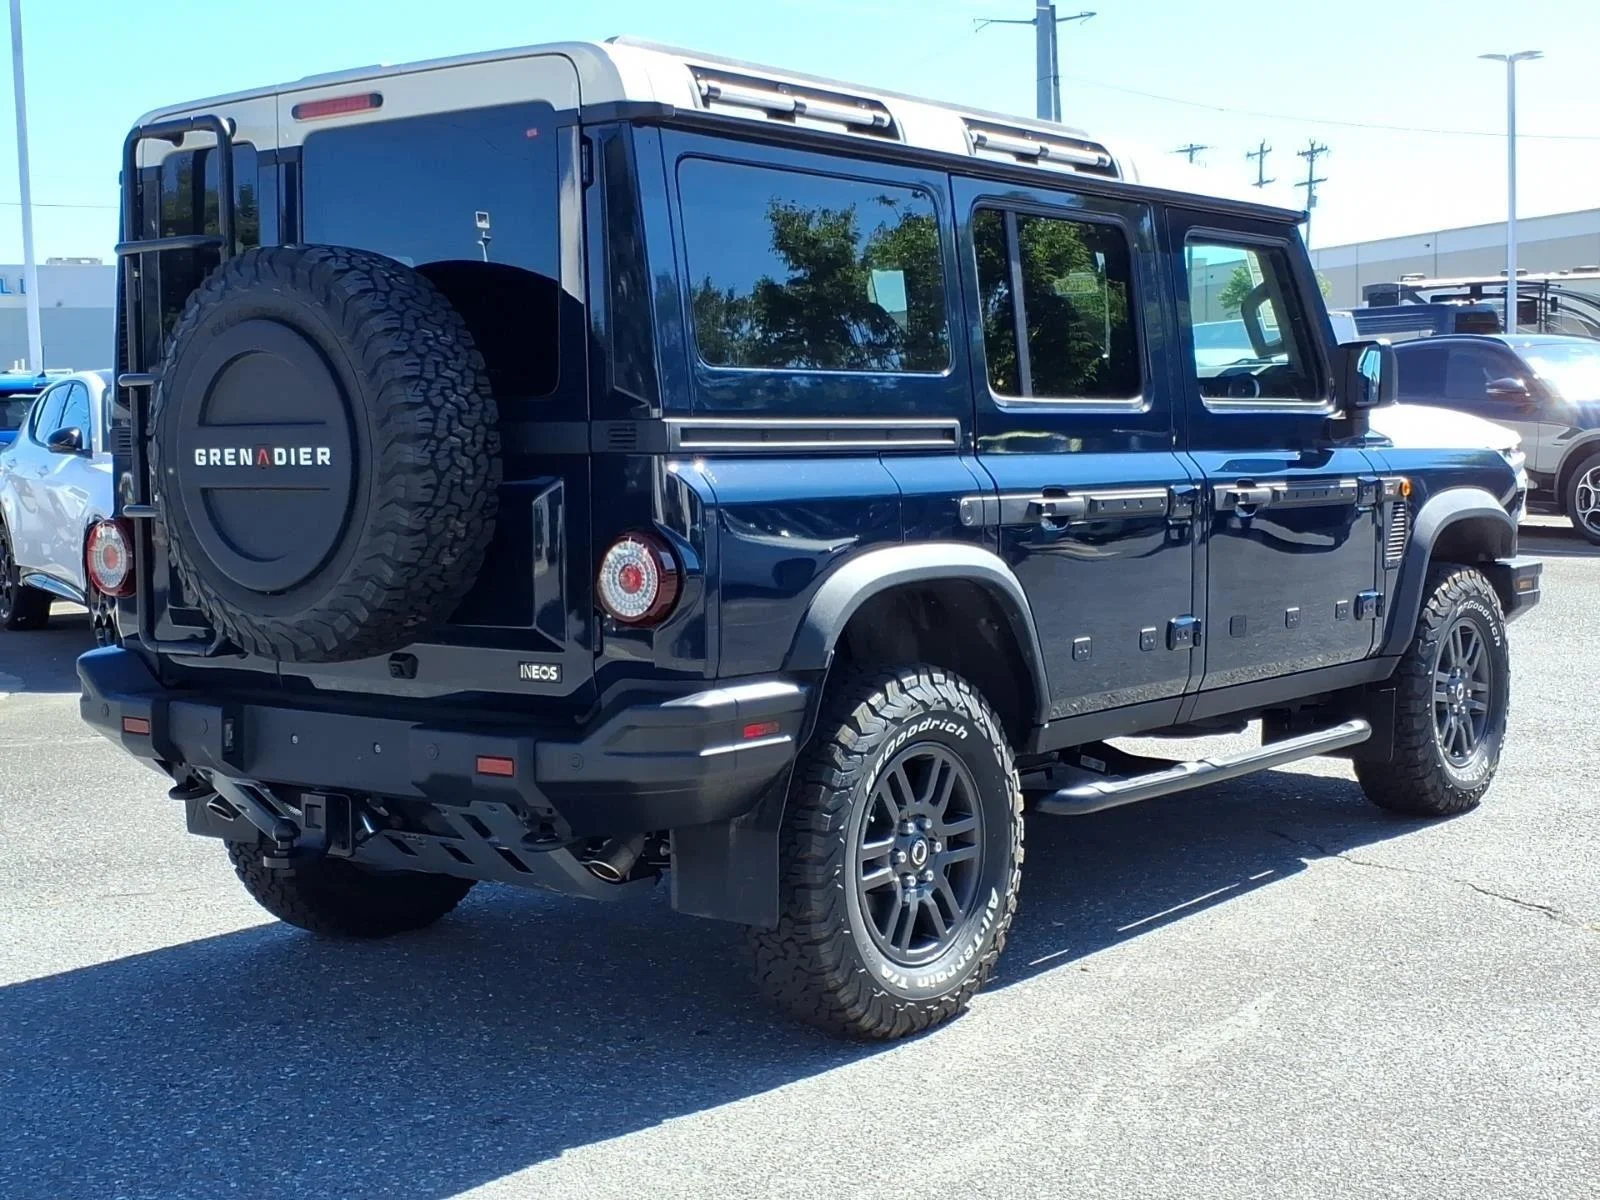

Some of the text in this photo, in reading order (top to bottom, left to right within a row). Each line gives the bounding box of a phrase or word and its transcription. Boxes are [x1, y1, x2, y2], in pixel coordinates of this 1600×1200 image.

[194, 447, 331, 466] GRENADIER
[520, 664, 558, 680] INEOS
[866, 717, 968, 796] BFGoodrich
[916, 887, 999, 988] All-Terrain
[881, 963, 909, 990] T/A
